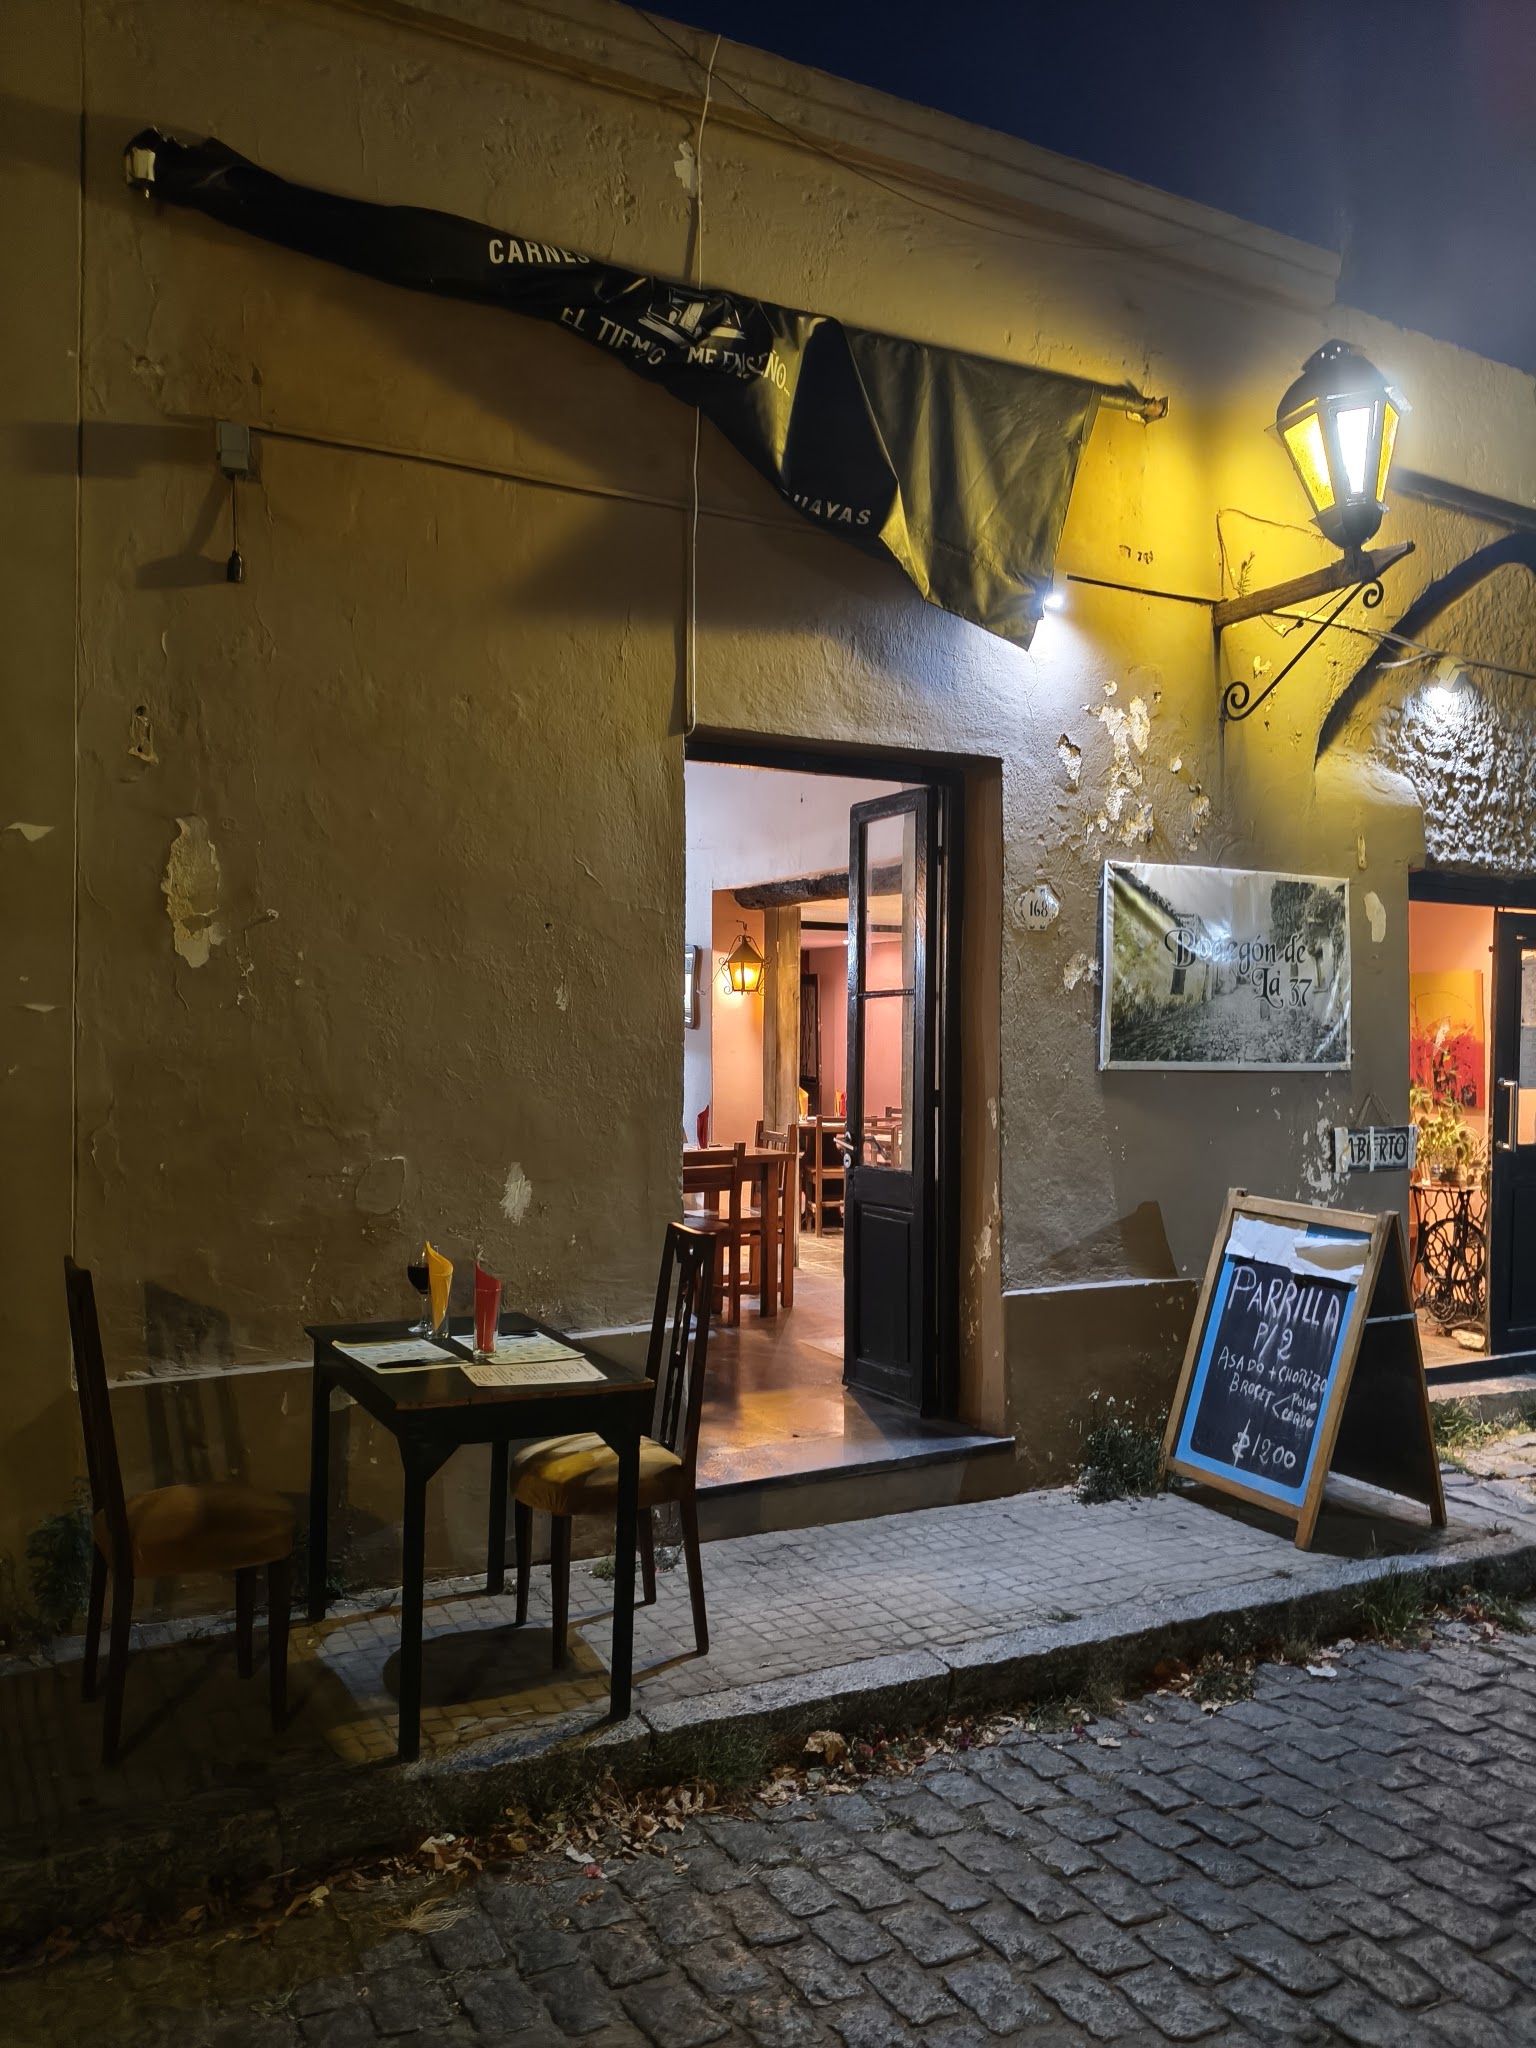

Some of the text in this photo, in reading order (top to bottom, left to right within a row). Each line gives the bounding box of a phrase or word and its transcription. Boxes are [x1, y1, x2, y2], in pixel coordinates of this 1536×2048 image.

[560, 307, 585, 332] EL
[597, 316, 667, 365] TIEMO
[1028, 899, 1049, 919] 168
[1164, 929, 1307, 975] Bodegón de
[1288, 978, 1313, 1007] 37
[1227, 1266, 1340, 1337] PARRILLA
[1217, 1345, 1265, 1374] ASADO
